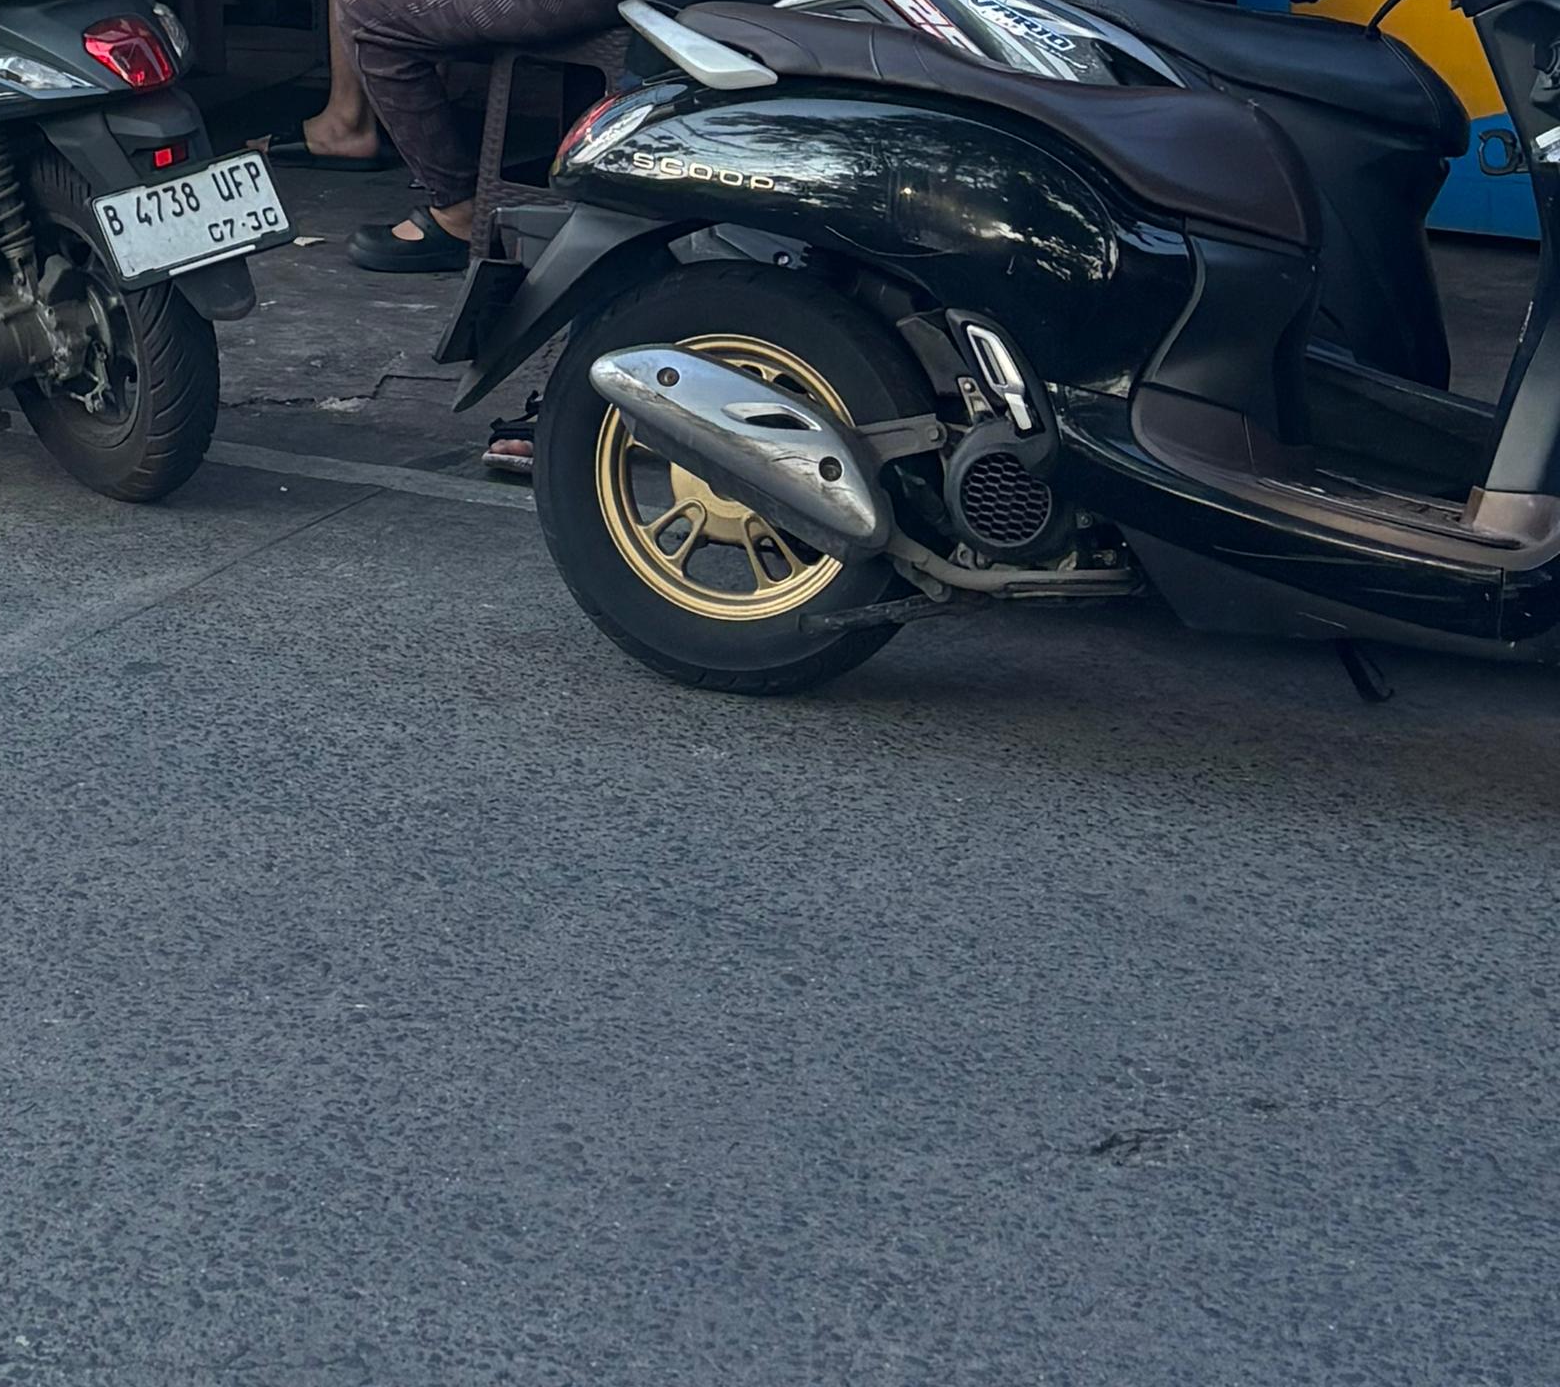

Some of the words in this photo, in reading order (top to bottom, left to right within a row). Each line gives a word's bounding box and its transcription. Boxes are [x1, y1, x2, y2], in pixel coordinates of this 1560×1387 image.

[102, 204, 125, 236] B
[135, 182, 201, 227] 4738
[211, 161, 261, 202] UFP
